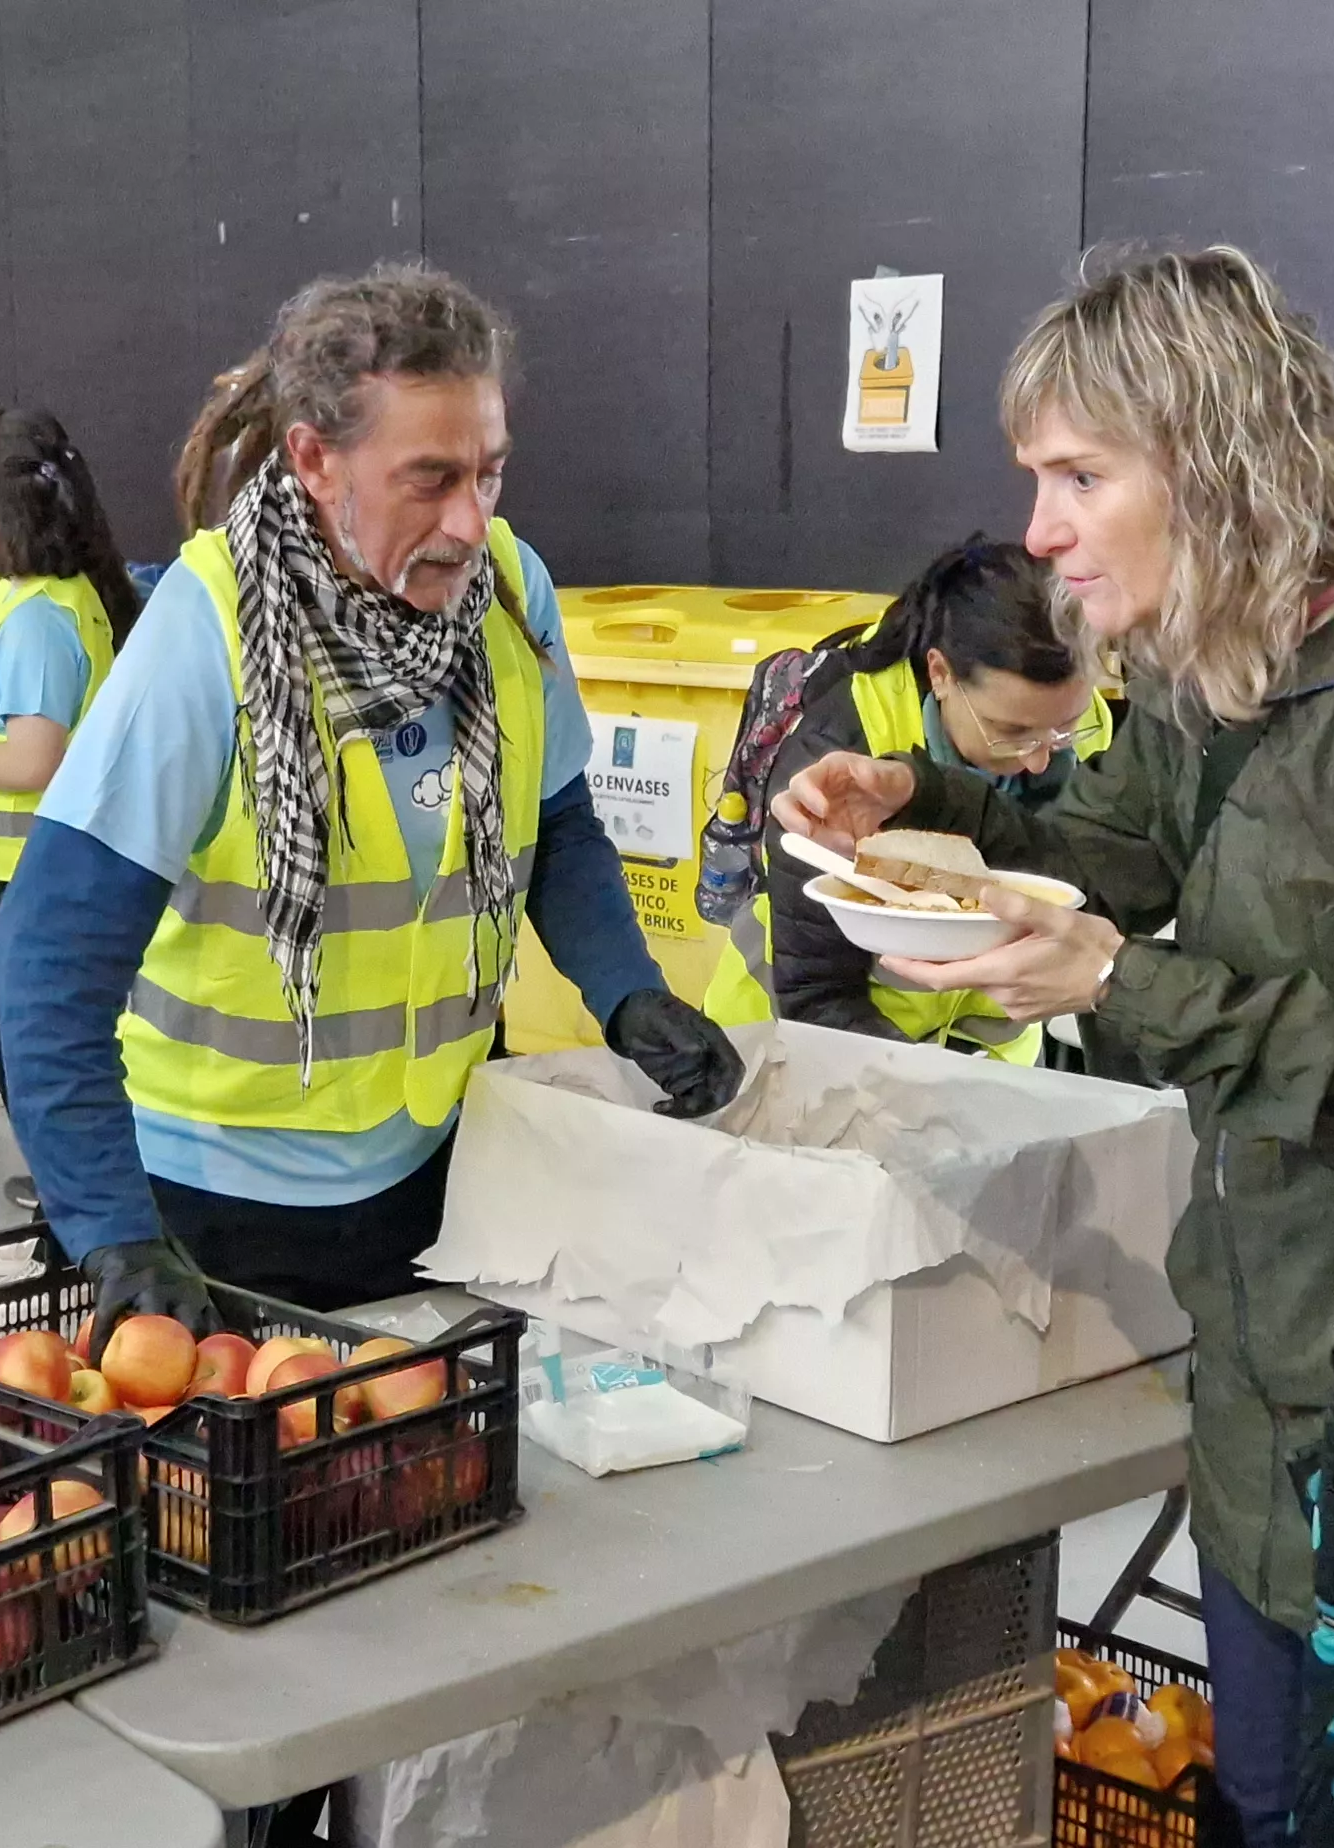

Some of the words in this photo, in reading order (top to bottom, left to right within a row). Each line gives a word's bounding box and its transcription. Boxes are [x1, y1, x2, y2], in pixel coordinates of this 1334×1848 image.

[607, 775, 670, 797] ENVASES
[659, 877, 678, 893] DE
[644, 913, 685, 932] BRIKS
